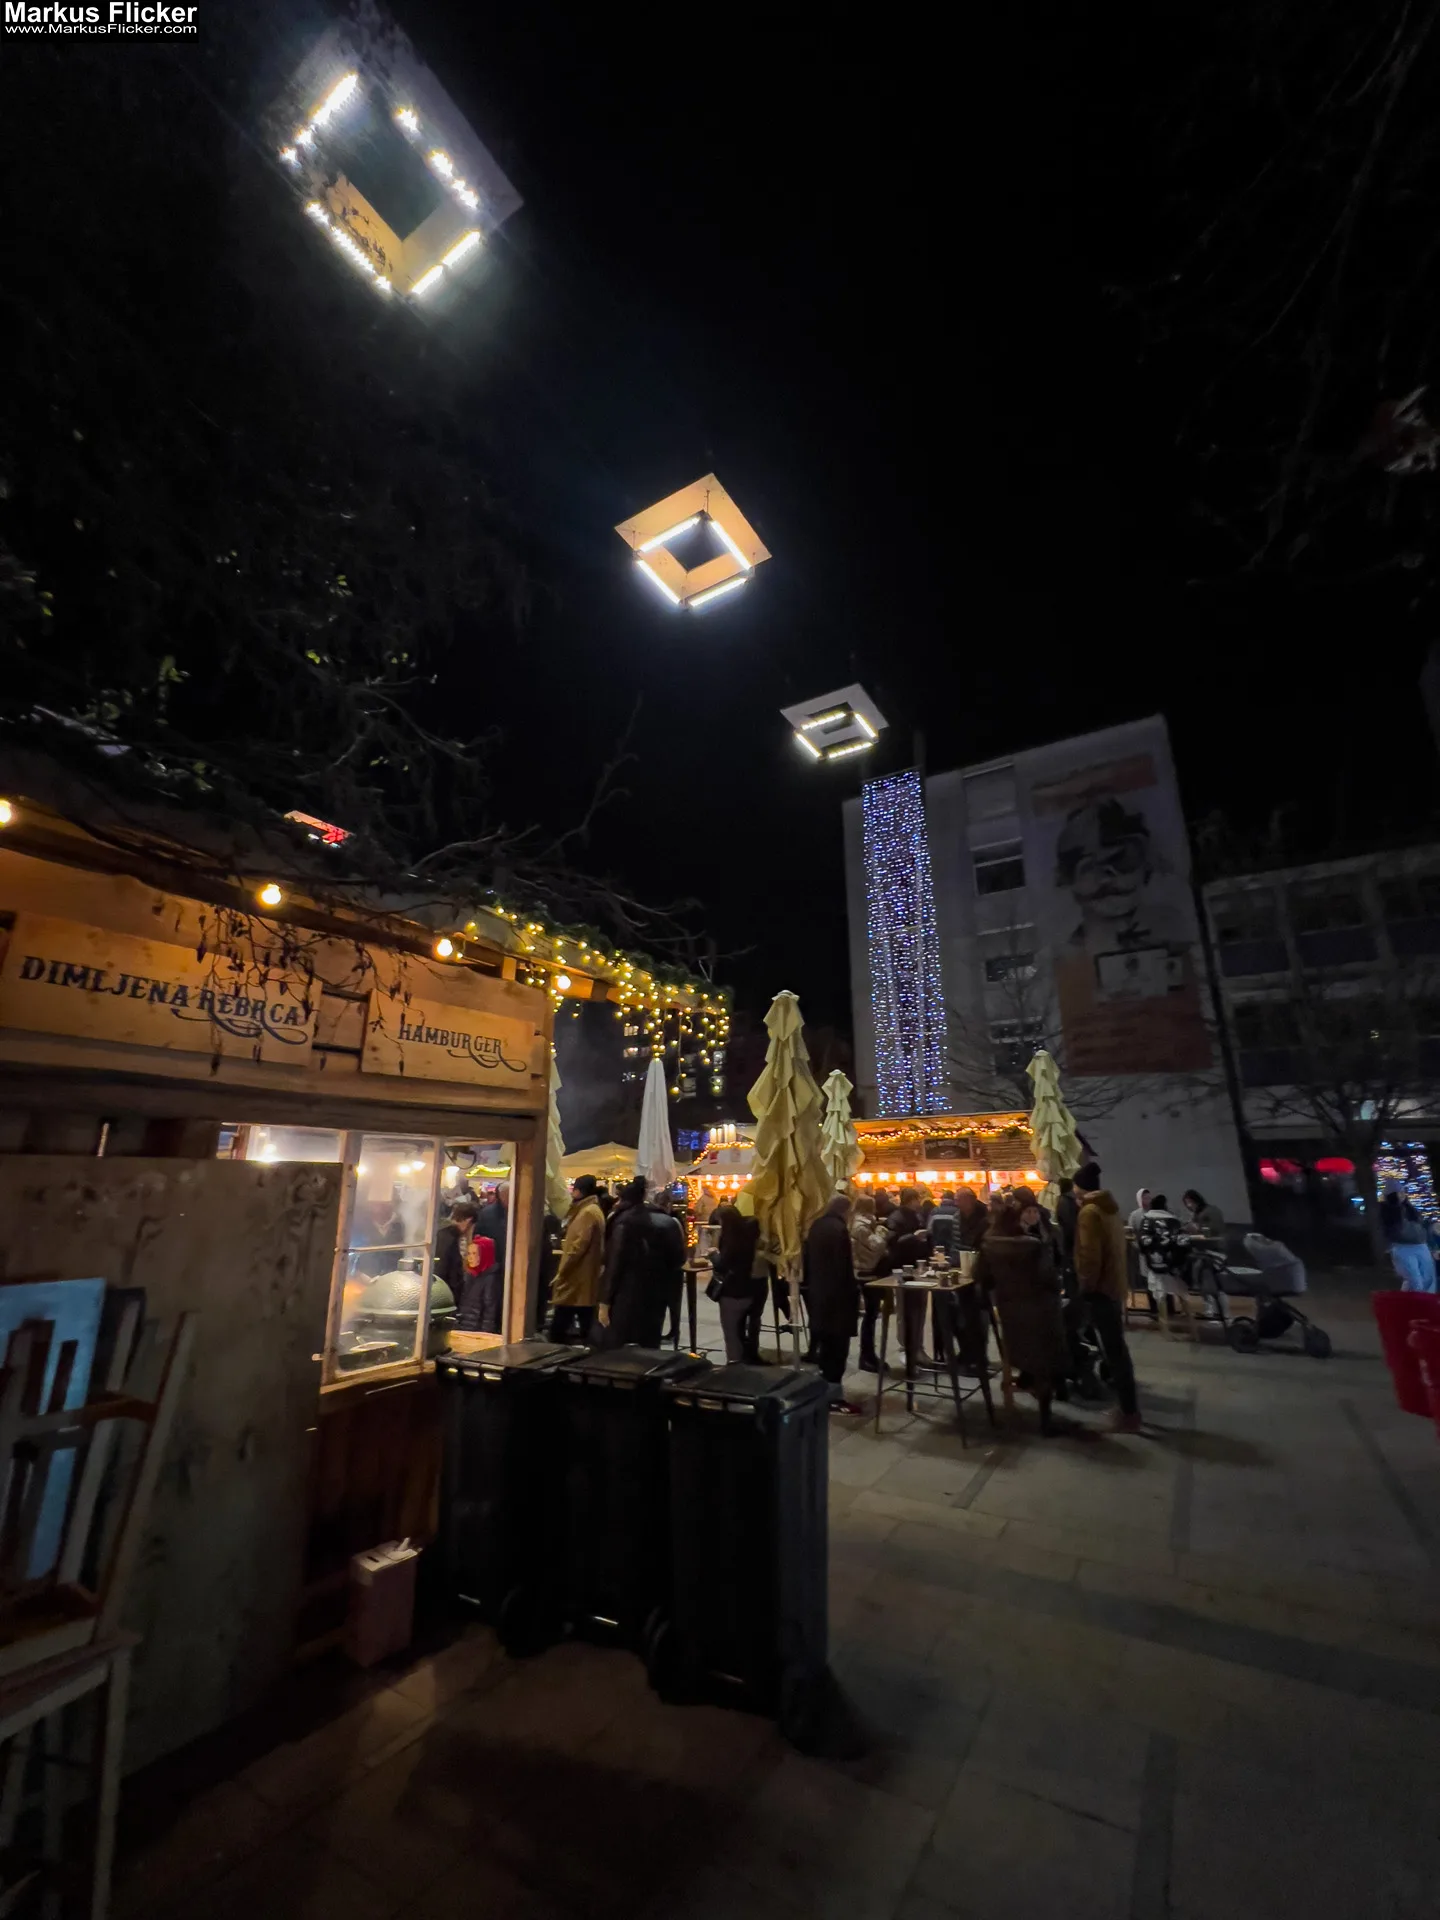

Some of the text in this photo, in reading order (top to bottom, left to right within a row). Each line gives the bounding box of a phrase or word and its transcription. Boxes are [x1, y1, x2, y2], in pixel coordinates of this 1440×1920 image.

[19, 955, 308, 1045] DIMLJENA REBRCA
[398, 1023, 523, 1069] HAMBURGER
